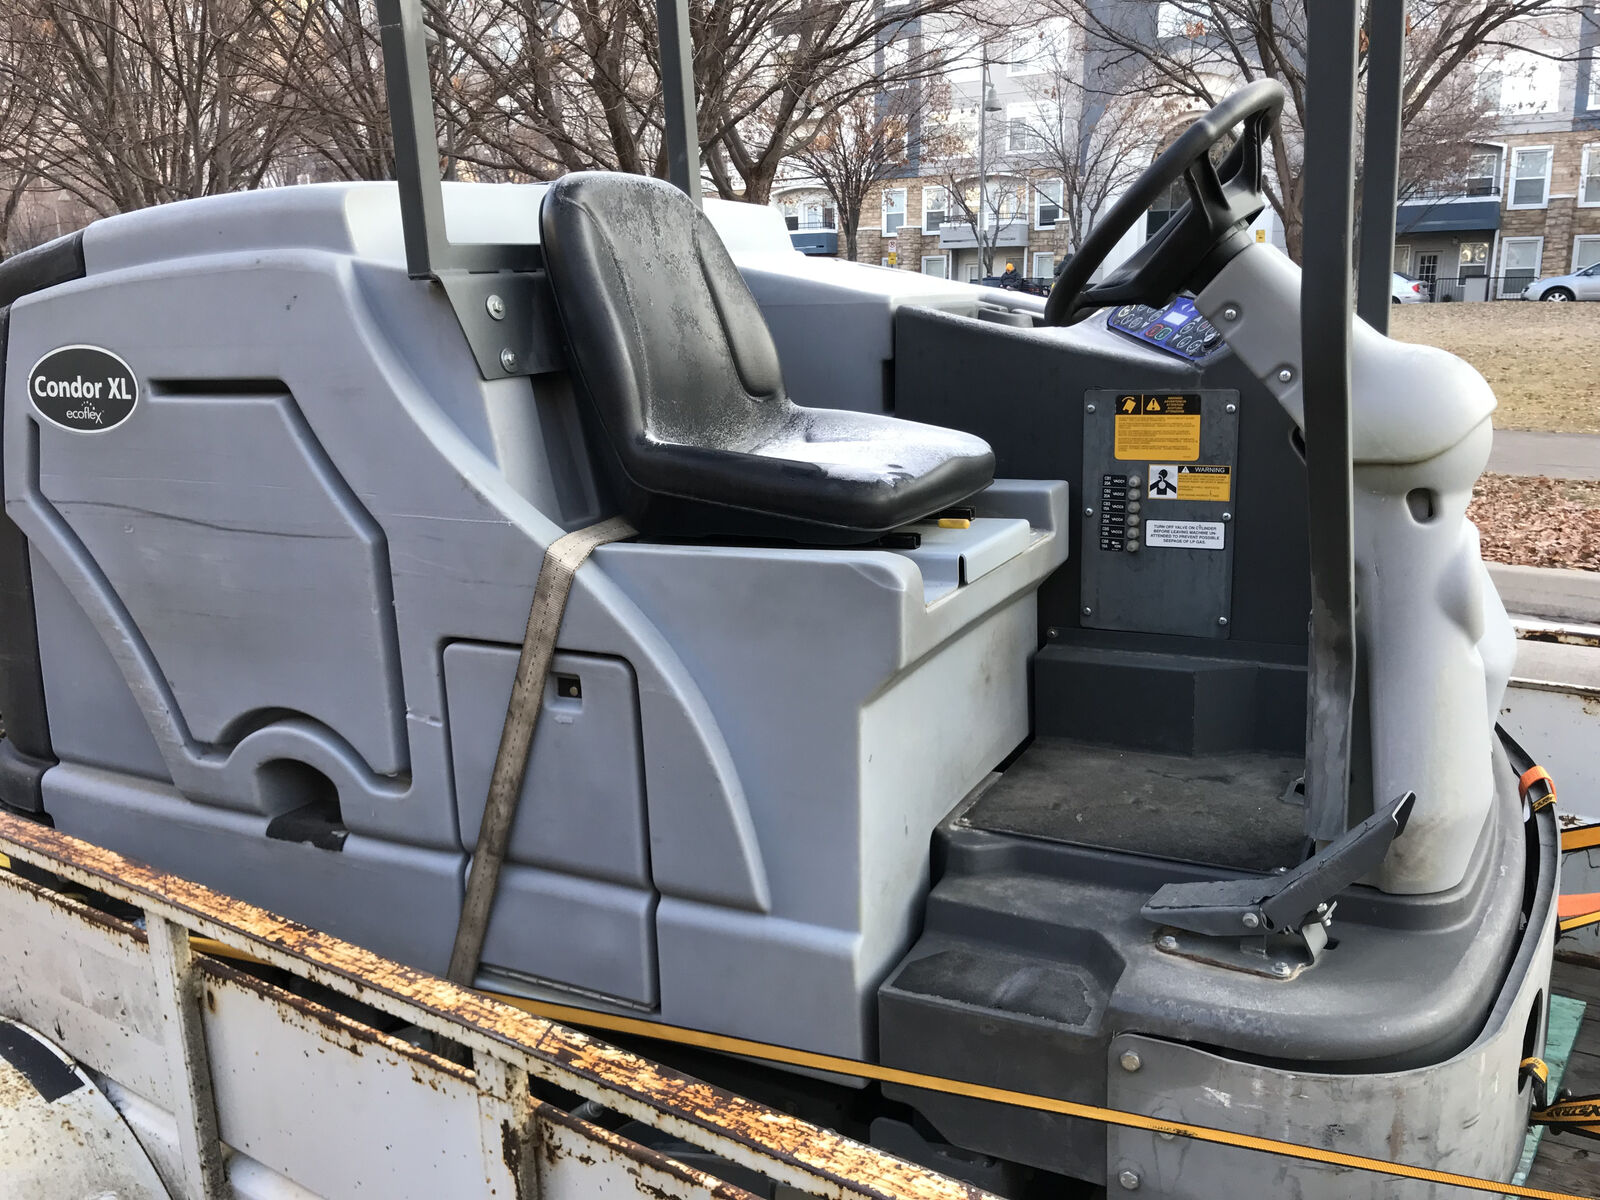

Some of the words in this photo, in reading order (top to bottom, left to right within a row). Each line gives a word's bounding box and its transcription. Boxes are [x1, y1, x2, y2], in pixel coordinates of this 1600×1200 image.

[34, 375, 103, 398] Condor
[107, 377, 132, 400] XL
[66, 406, 103, 424] ecoflex
